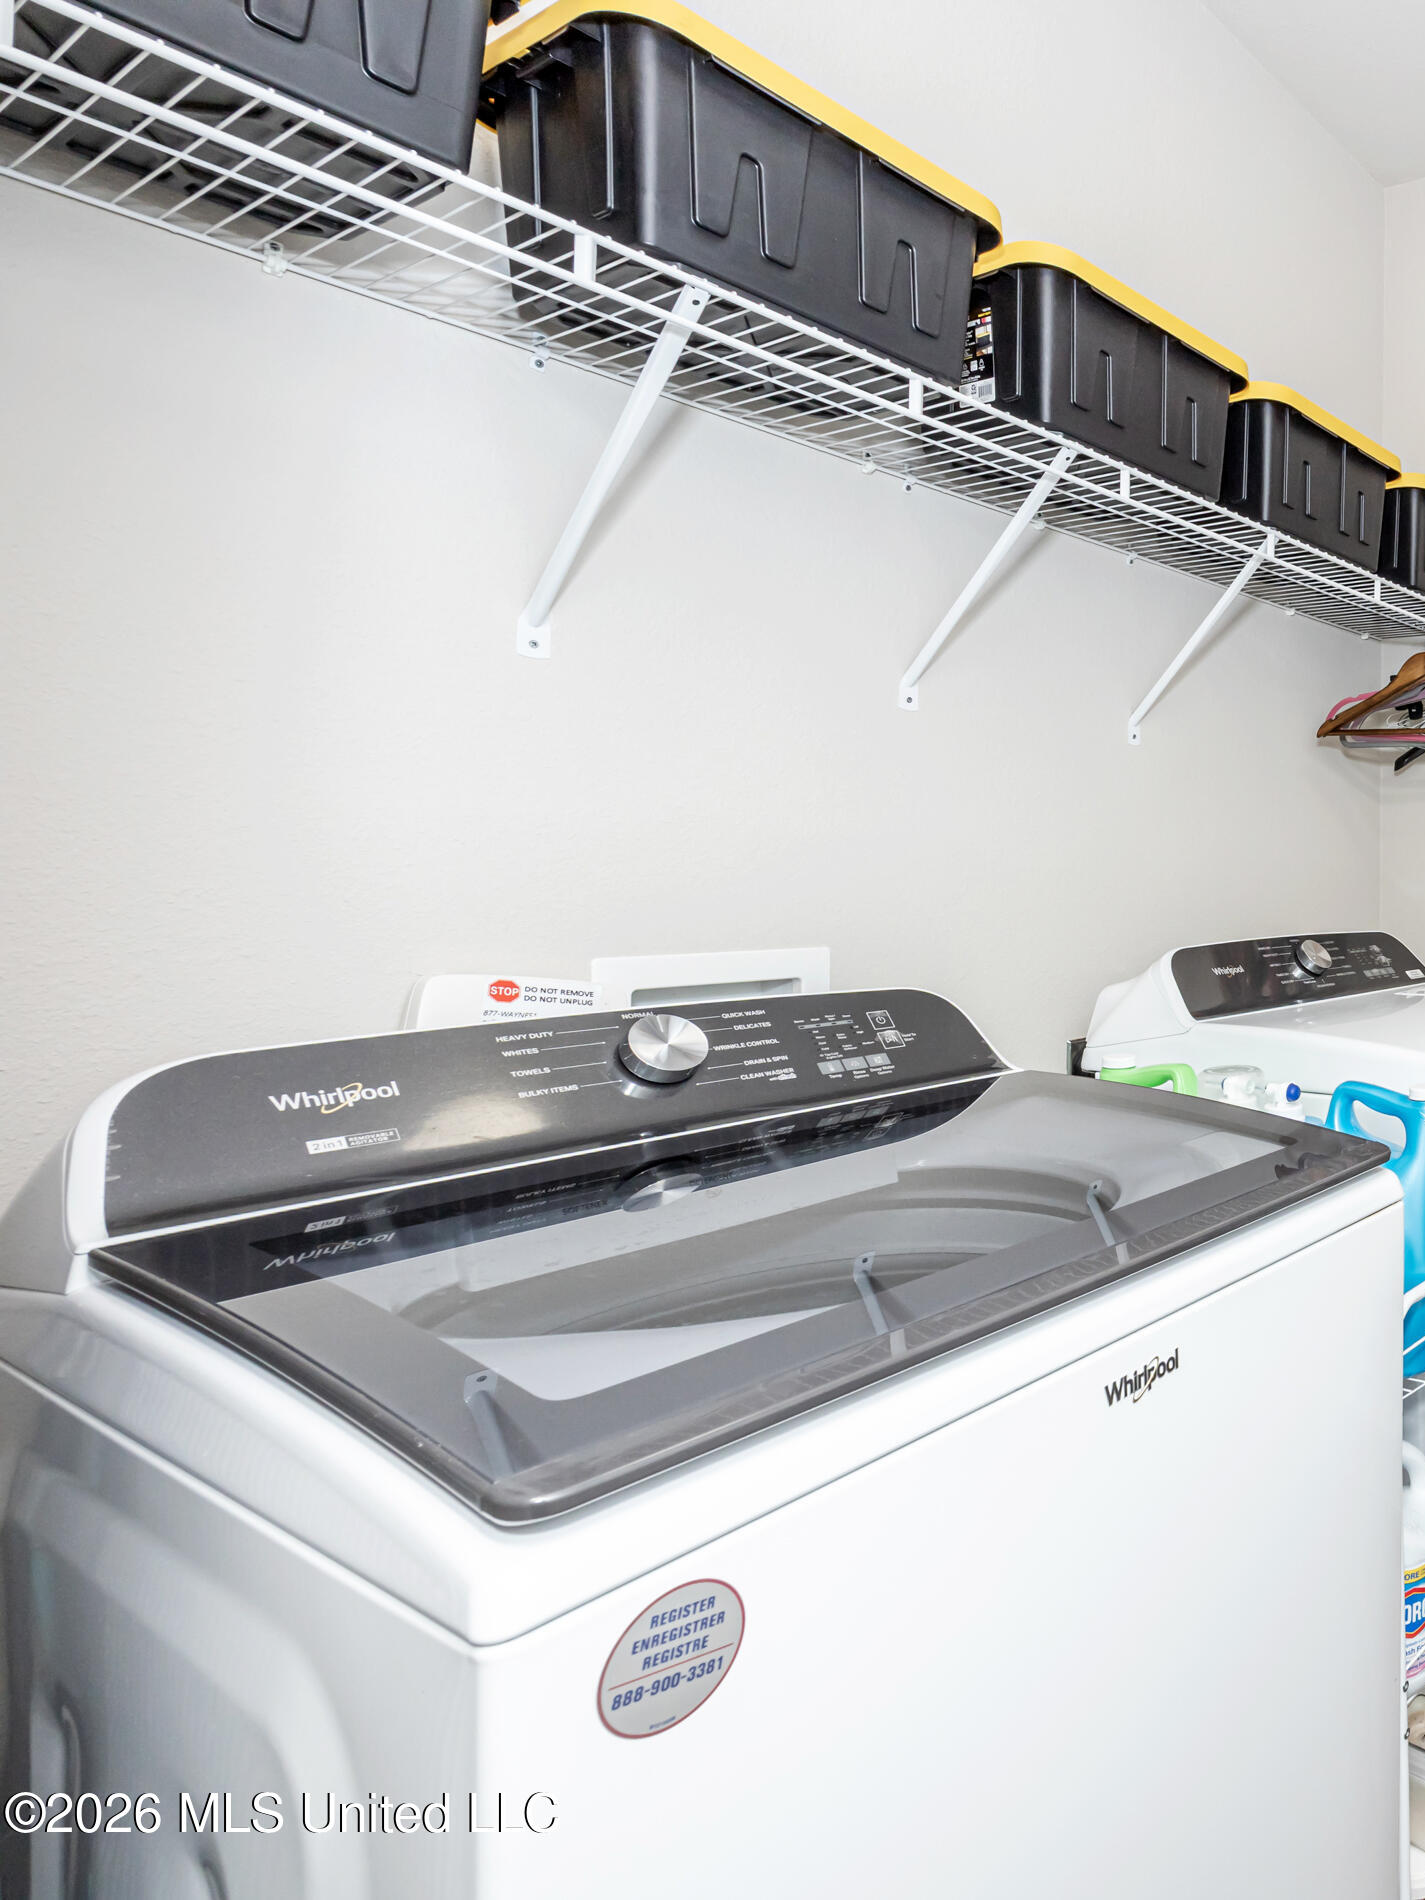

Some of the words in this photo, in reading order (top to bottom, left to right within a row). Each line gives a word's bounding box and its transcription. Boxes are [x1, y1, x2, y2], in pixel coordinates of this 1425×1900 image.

[1211, 964, 1245, 977] Whirlpool
[489, 986, 520, 996] STOP
[540, 987, 558, 995] NOT
[560, 989, 594, 998] REMOVE
[539, 996, 558, 1004] NOT
[560, 998, 593, 1007] UNPLUG
[721, 1011, 744, 1019] QUICK
[733, 1021, 772, 1031] DELICATES
[495, 1034, 527, 1043] HEAVY
[528, 1031, 553, 1039] DUTY
[712, 1041, 747, 1051] WRINKLE
[746, 1038, 780, 1048] CONTROL
[501, 1047, 540, 1057] WHITES
[743, 1058, 767, 1066] DRAIN
[509, 1066, 551, 1078] TOWELS
[740, 1071, 765, 1081] CLEAN
[765, 1067, 795, 1077] WASHER
[267, 1080, 400, 1112] Whirlpool
[517, 1087, 549, 1099] BULKY
[550, 1084, 579, 1094] ITEMS
[347, 1130, 394, 1142] REMOVABLE
[349, 1136, 390, 1147] AGITATOR
[1104, 1347, 1179, 1407] Whirlpool
[1404, 1571, 1420, 1581] ORE
[650, 1595, 716, 1629] REGISTER
[631, 1611, 726, 1655] ENREGISTRER
[642, 1634, 710, 1671] REGISTRE
[610, 1655, 724, 1711] 888-900-3381
